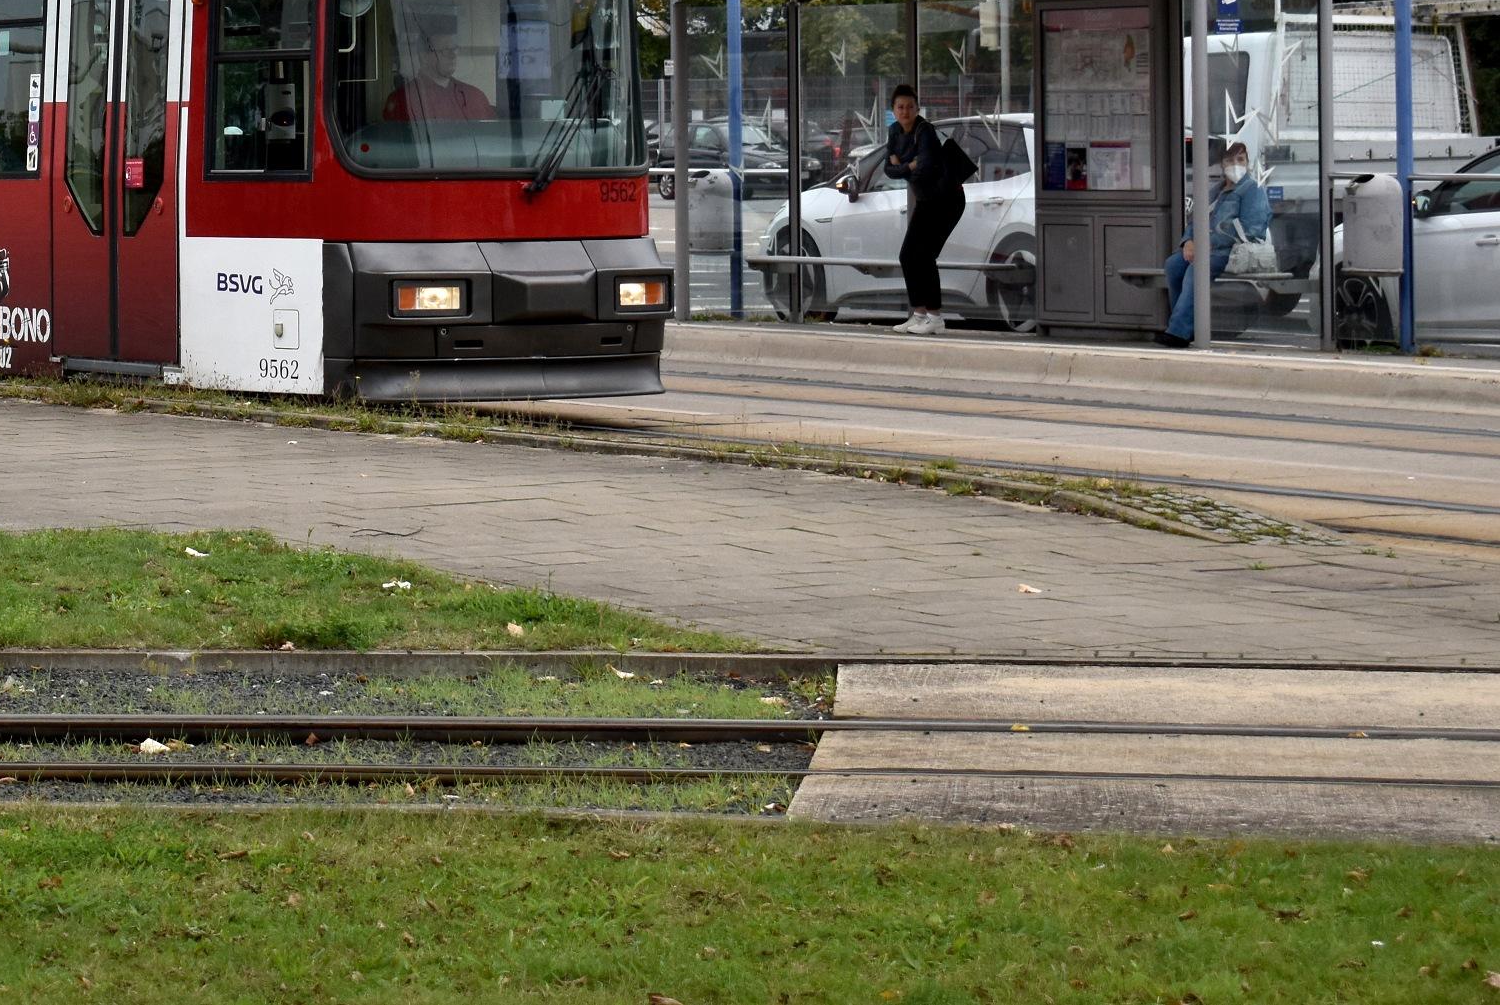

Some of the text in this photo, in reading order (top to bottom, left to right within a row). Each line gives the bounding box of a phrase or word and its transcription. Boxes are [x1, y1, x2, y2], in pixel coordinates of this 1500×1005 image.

[600, 181, 636, 202] 9562
[217, 272, 263, 294] BSVG
[0, 346, 12, 369] U2
[259, 358, 299, 380] 9562
